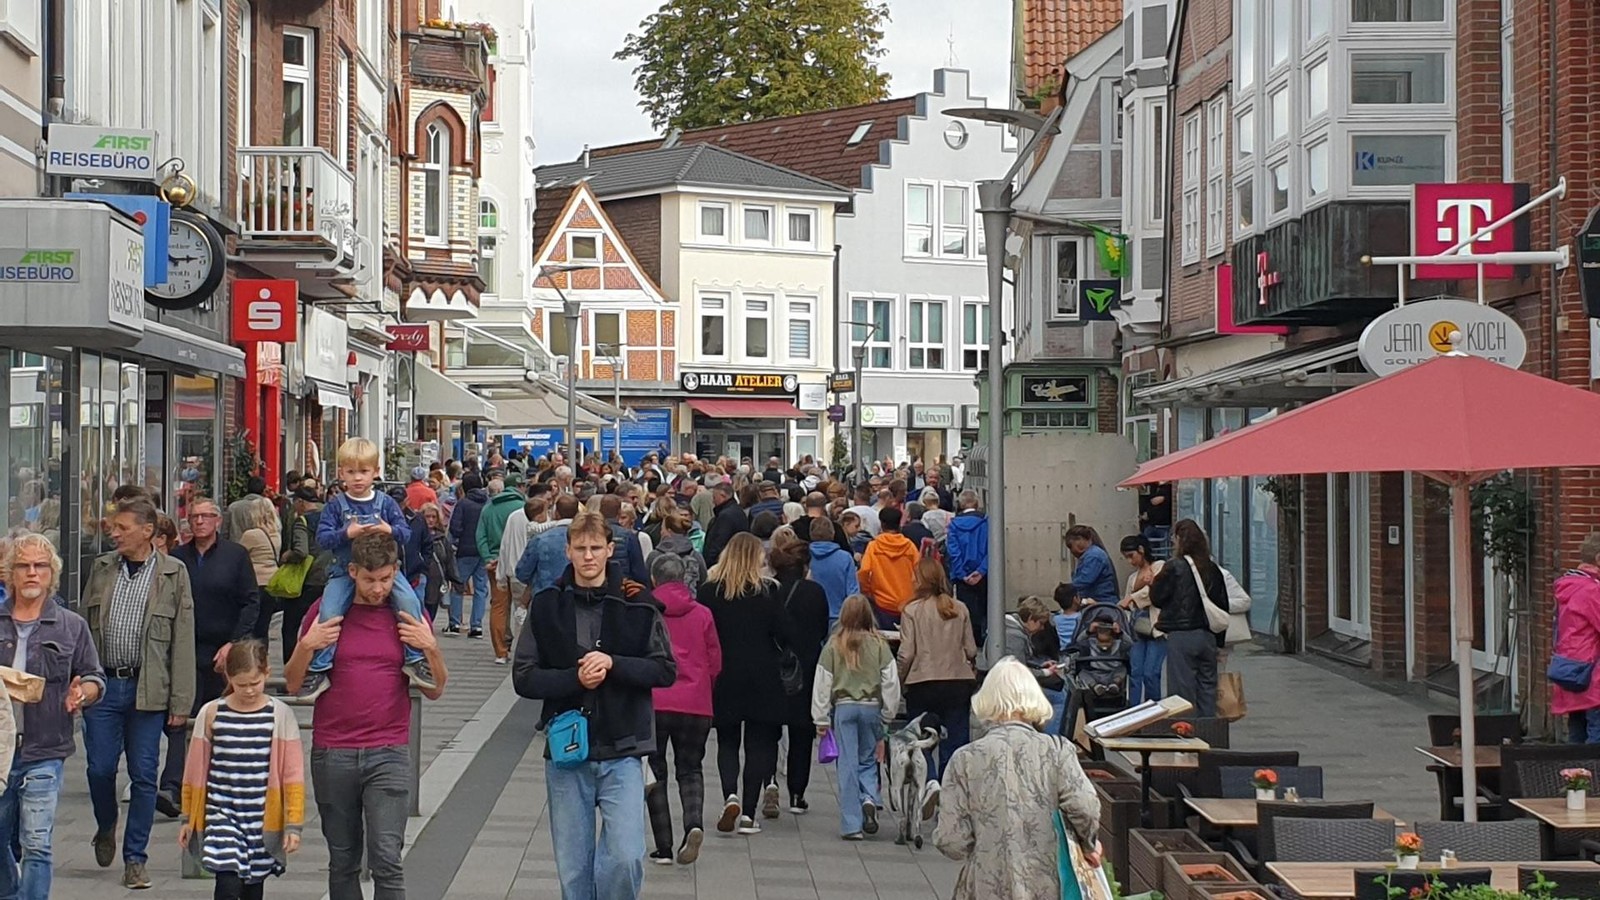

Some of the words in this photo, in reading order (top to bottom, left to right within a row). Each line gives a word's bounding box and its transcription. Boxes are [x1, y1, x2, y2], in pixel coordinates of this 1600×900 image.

[93, 134, 152, 151] FIRST
[50, 151, 150, 170] REISEBÜRO
[1437, 199, 1492, 256] T
[20, 250, 74, 264] FIRST
[1384, 323, 1422, 353] JEAN
[1467, 321, 1506, 351] KOCH
[700, 374, 732, 386] HAAR
[735, 375, 782, 387] ATELIER
